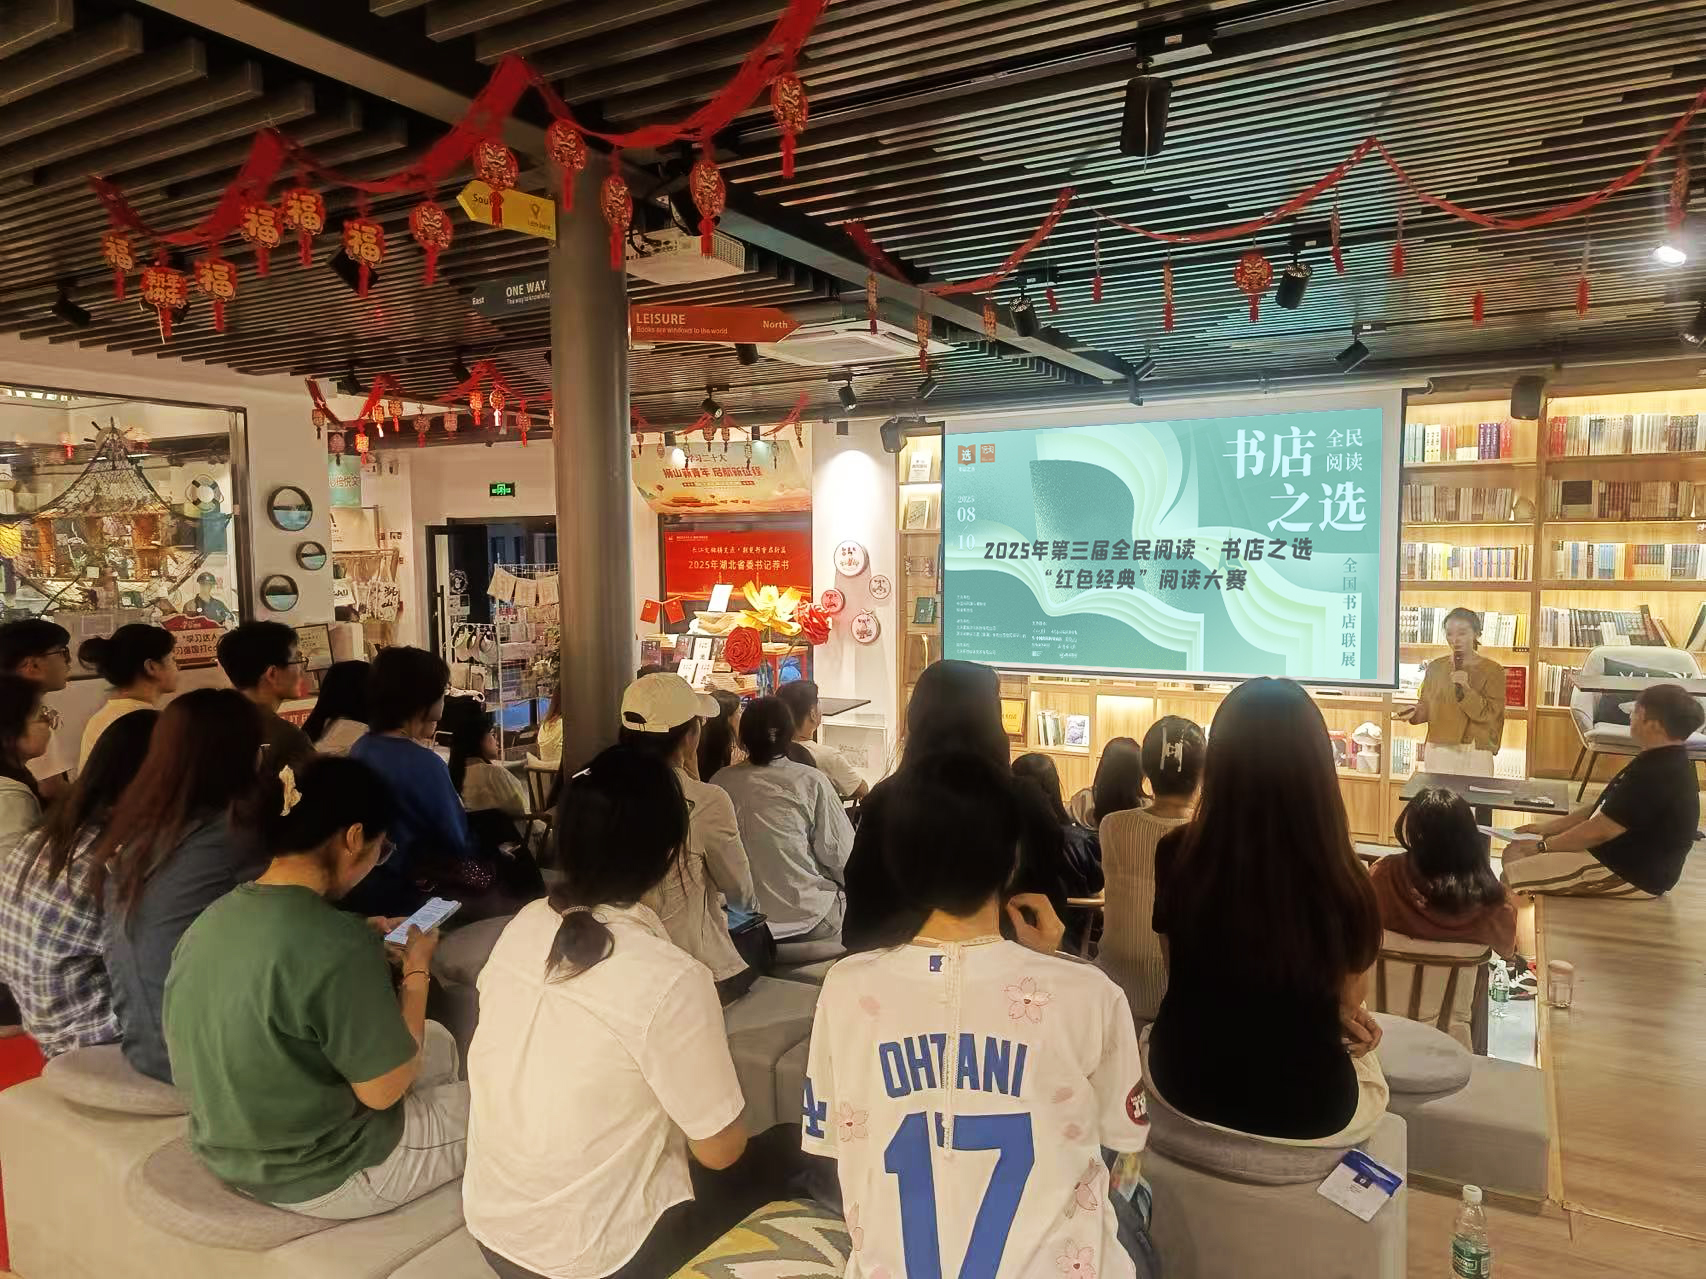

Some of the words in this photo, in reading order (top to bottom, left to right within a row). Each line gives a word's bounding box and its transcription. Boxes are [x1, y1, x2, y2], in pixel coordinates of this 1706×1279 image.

[505, 285, 525, 298] ONE
[526, 280, 547, 294] WAY
[472, 296, 486, 305] East
[635, 313, 686, 325] LEISURE
[762, 320, 788, 329] North
[636, 325, 655, 333] Books
[1325, 428, 1363, 448] 全民
[961, 449, 972, 461] 选
[1222, 425, 1317, 480] 书店
[1326, 452, 1363, 473] 阅读
[957, 495, 975, 504] 2025
[1266, 481, 1367, 533] 之选
[957, 506, 976, 522] 08
[958, 534, 975, 550] 10
[1341, 557, 1358, 667] 全国书店联展
[878, 1032, 1029, 1099] OHTANI
[883, 1111, 1036, 1279] 17
